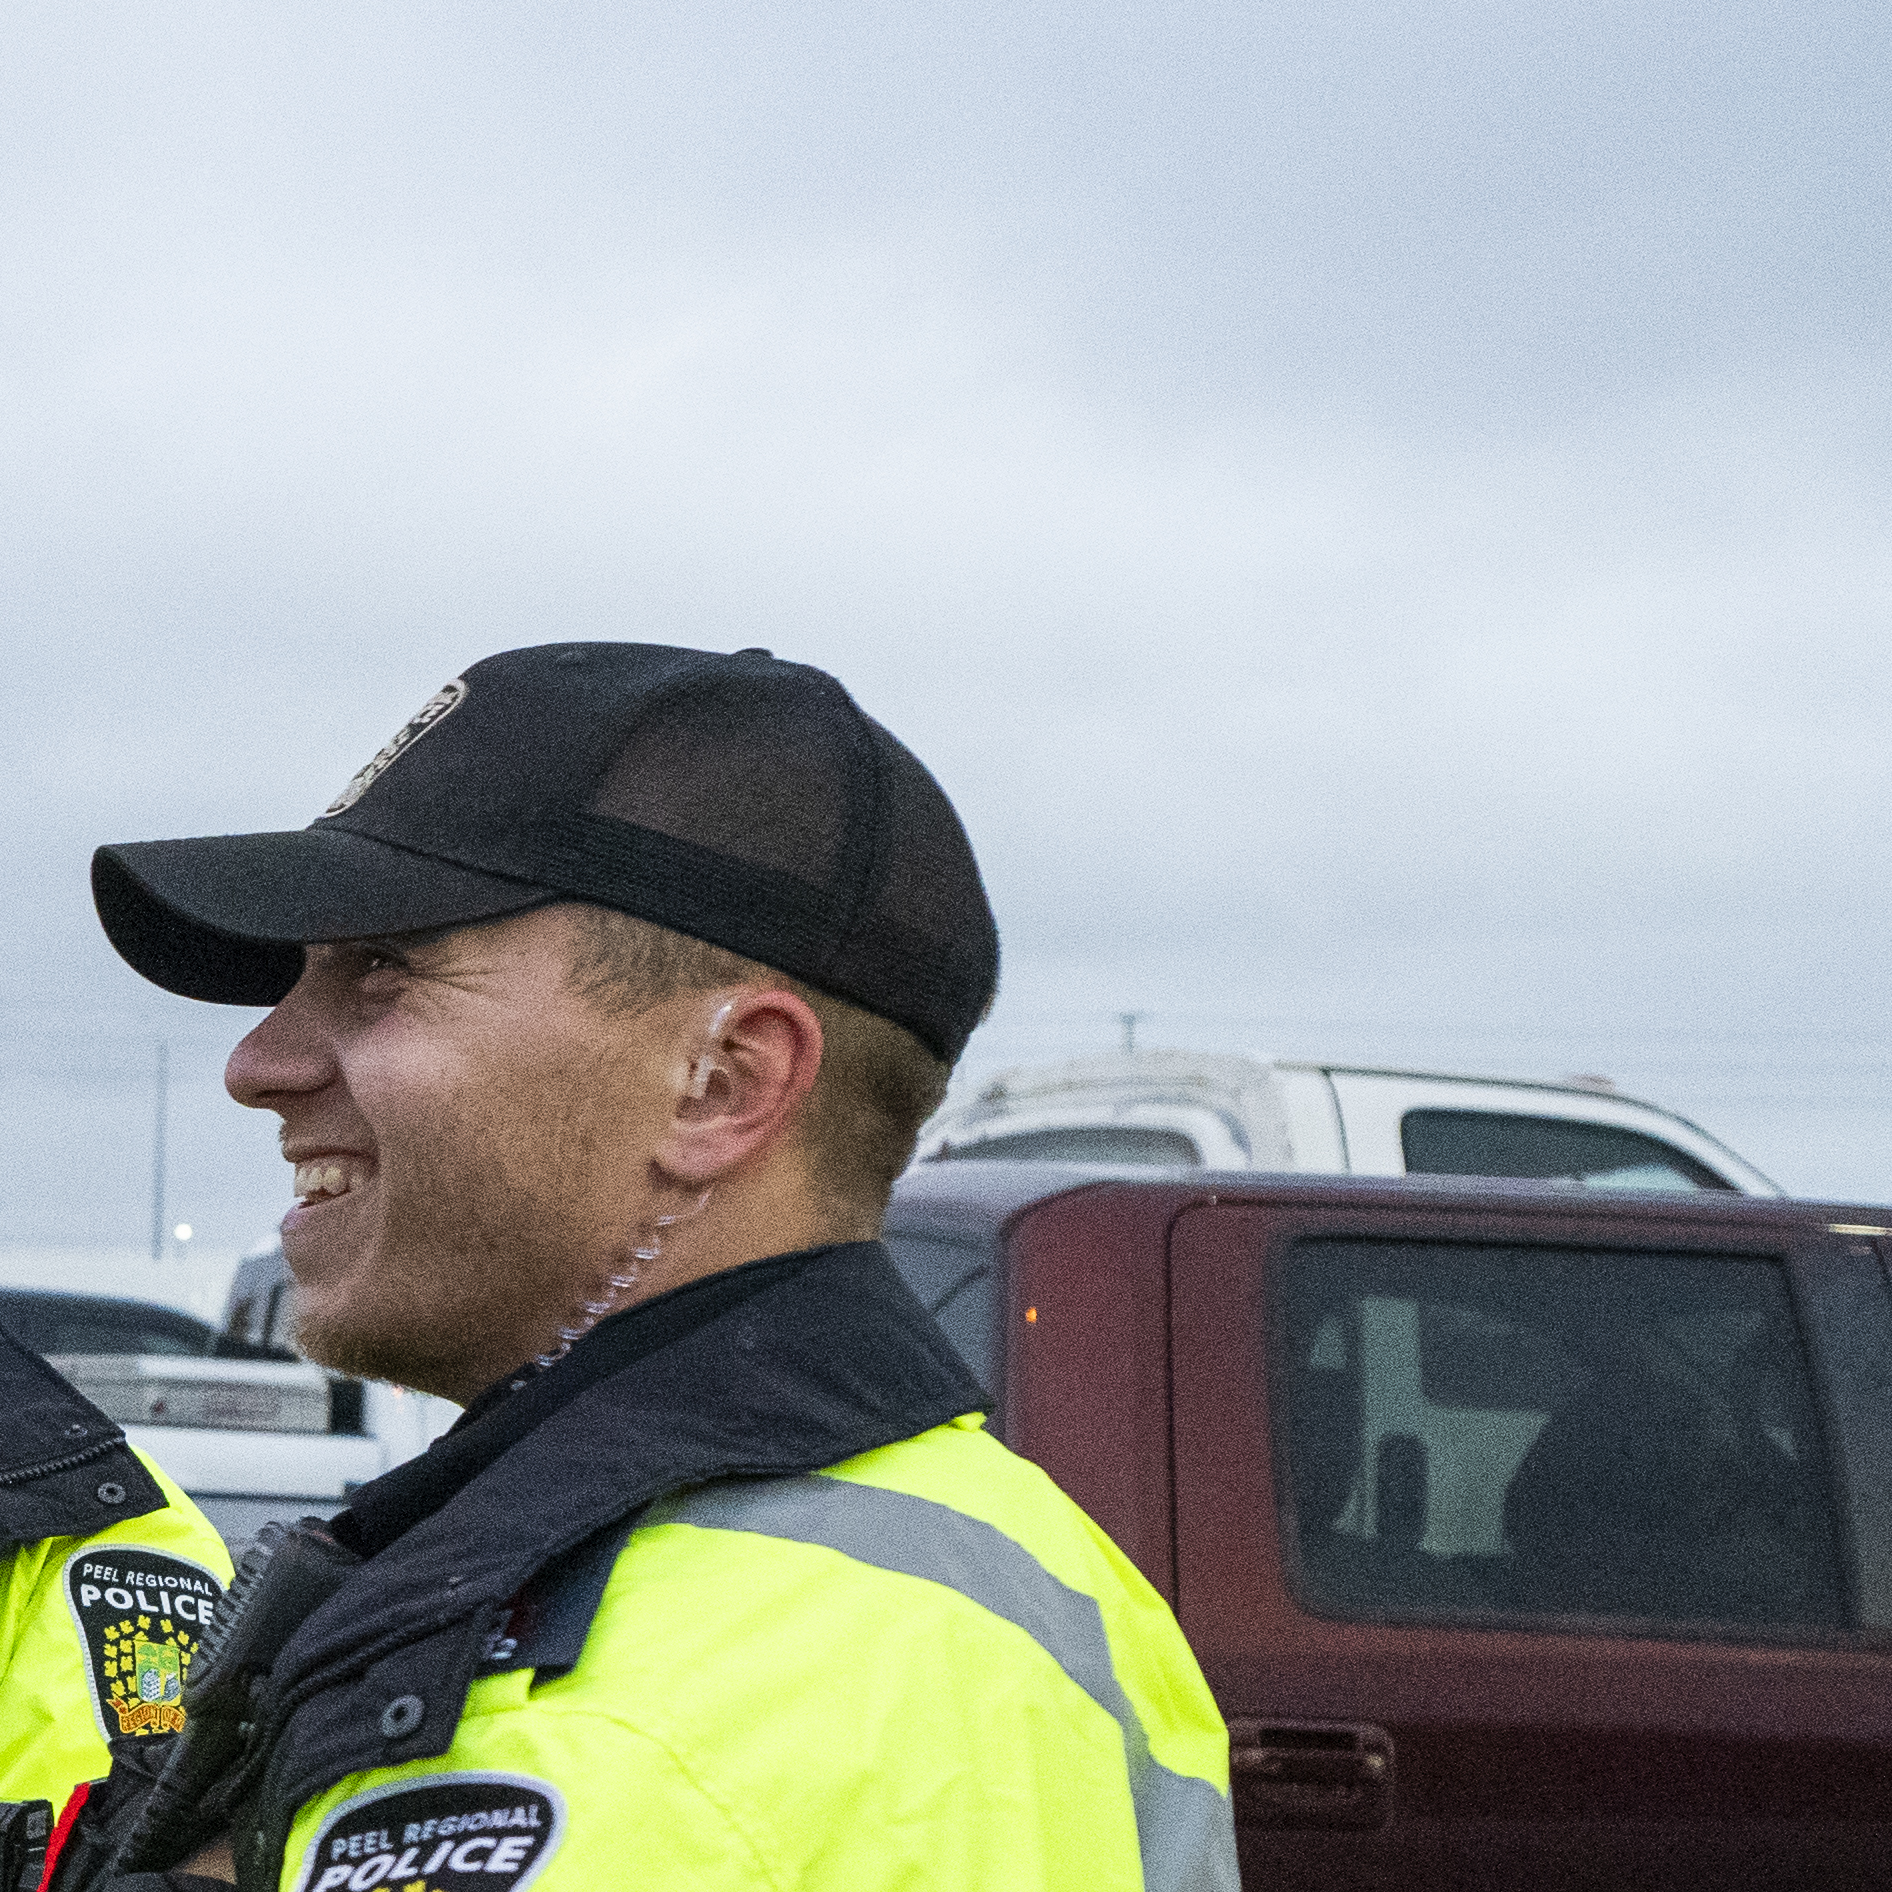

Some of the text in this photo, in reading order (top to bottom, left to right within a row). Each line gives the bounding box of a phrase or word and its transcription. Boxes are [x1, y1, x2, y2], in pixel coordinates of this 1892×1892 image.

[82, 1563, 213, 1597] PEEL REGIONAL
[80, 1583, 214, 1626] POLICE
[331, 1804, 543, 1861] PEEL REGIONAL
